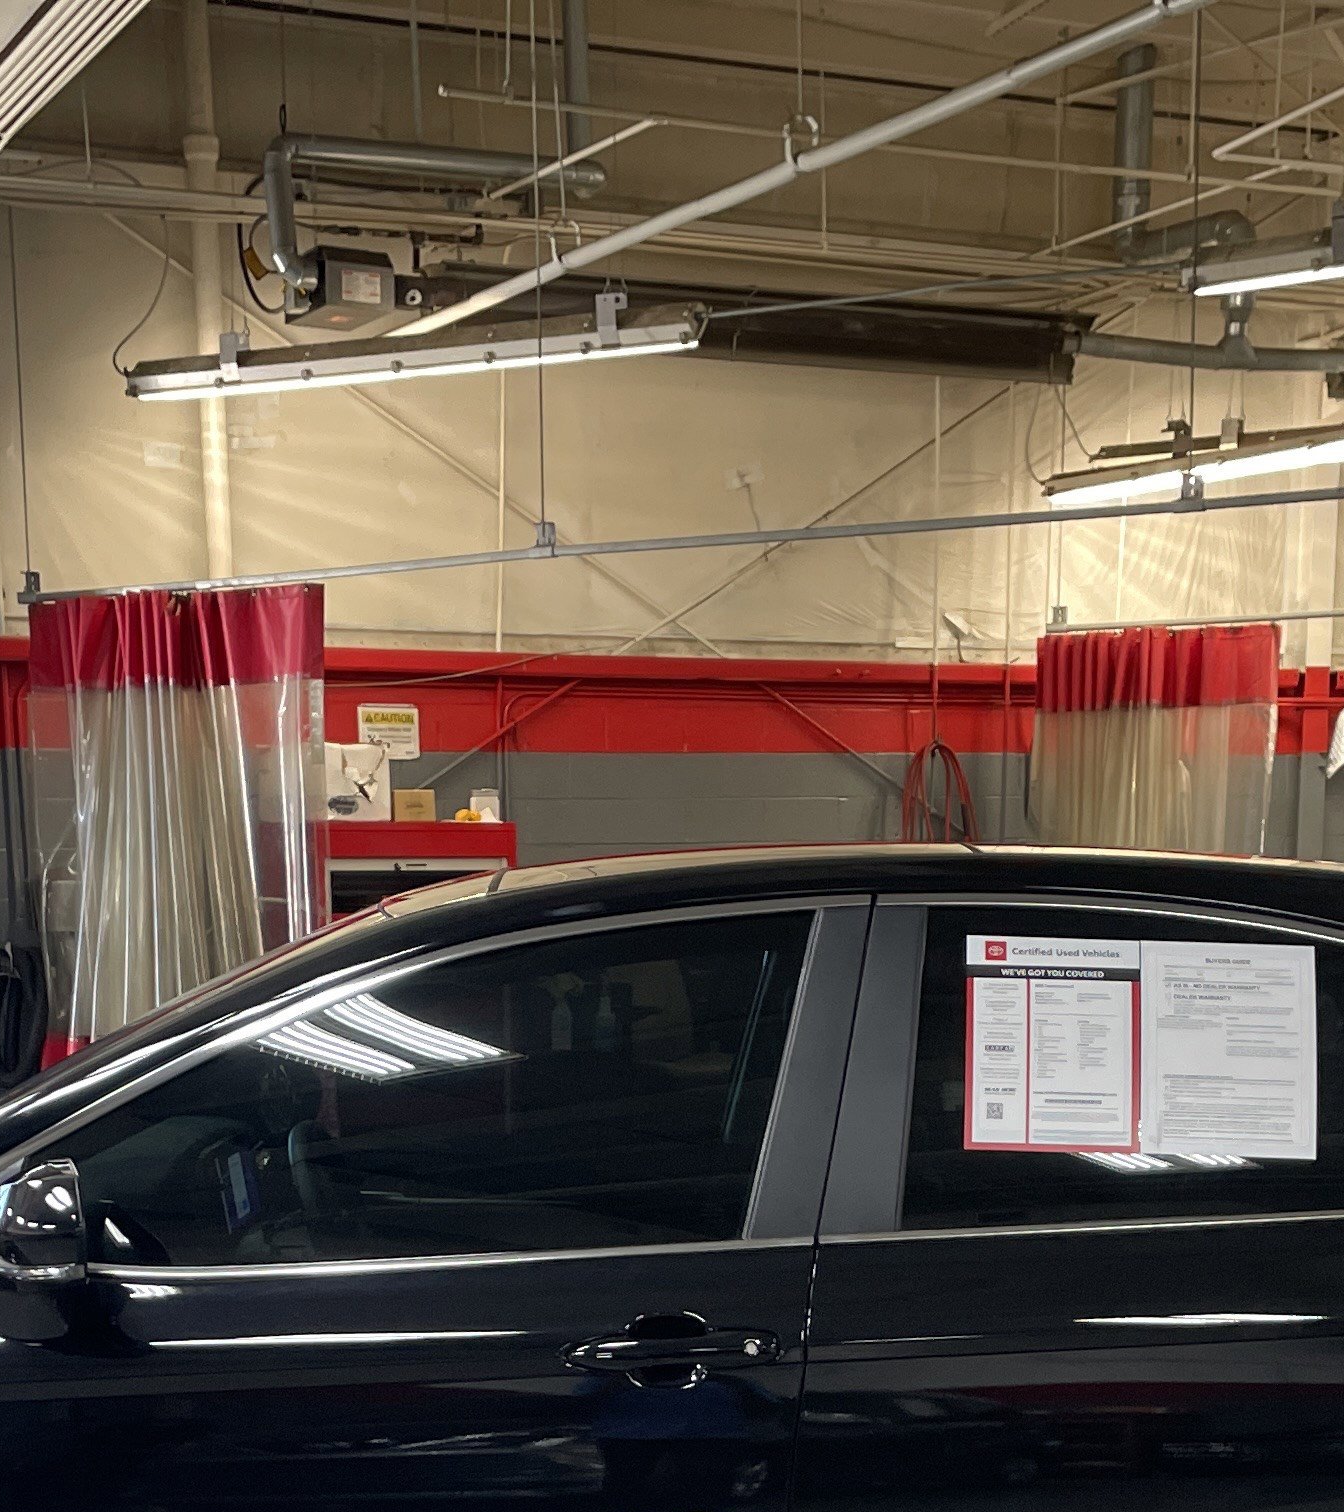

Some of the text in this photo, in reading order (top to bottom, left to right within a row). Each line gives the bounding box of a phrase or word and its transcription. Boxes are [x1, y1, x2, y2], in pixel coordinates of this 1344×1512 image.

[1011, 947, 1120, 958] Certified Used Vehicles
[1001, 968, 1105, 978] WE'VE GOT YOU COVERED
